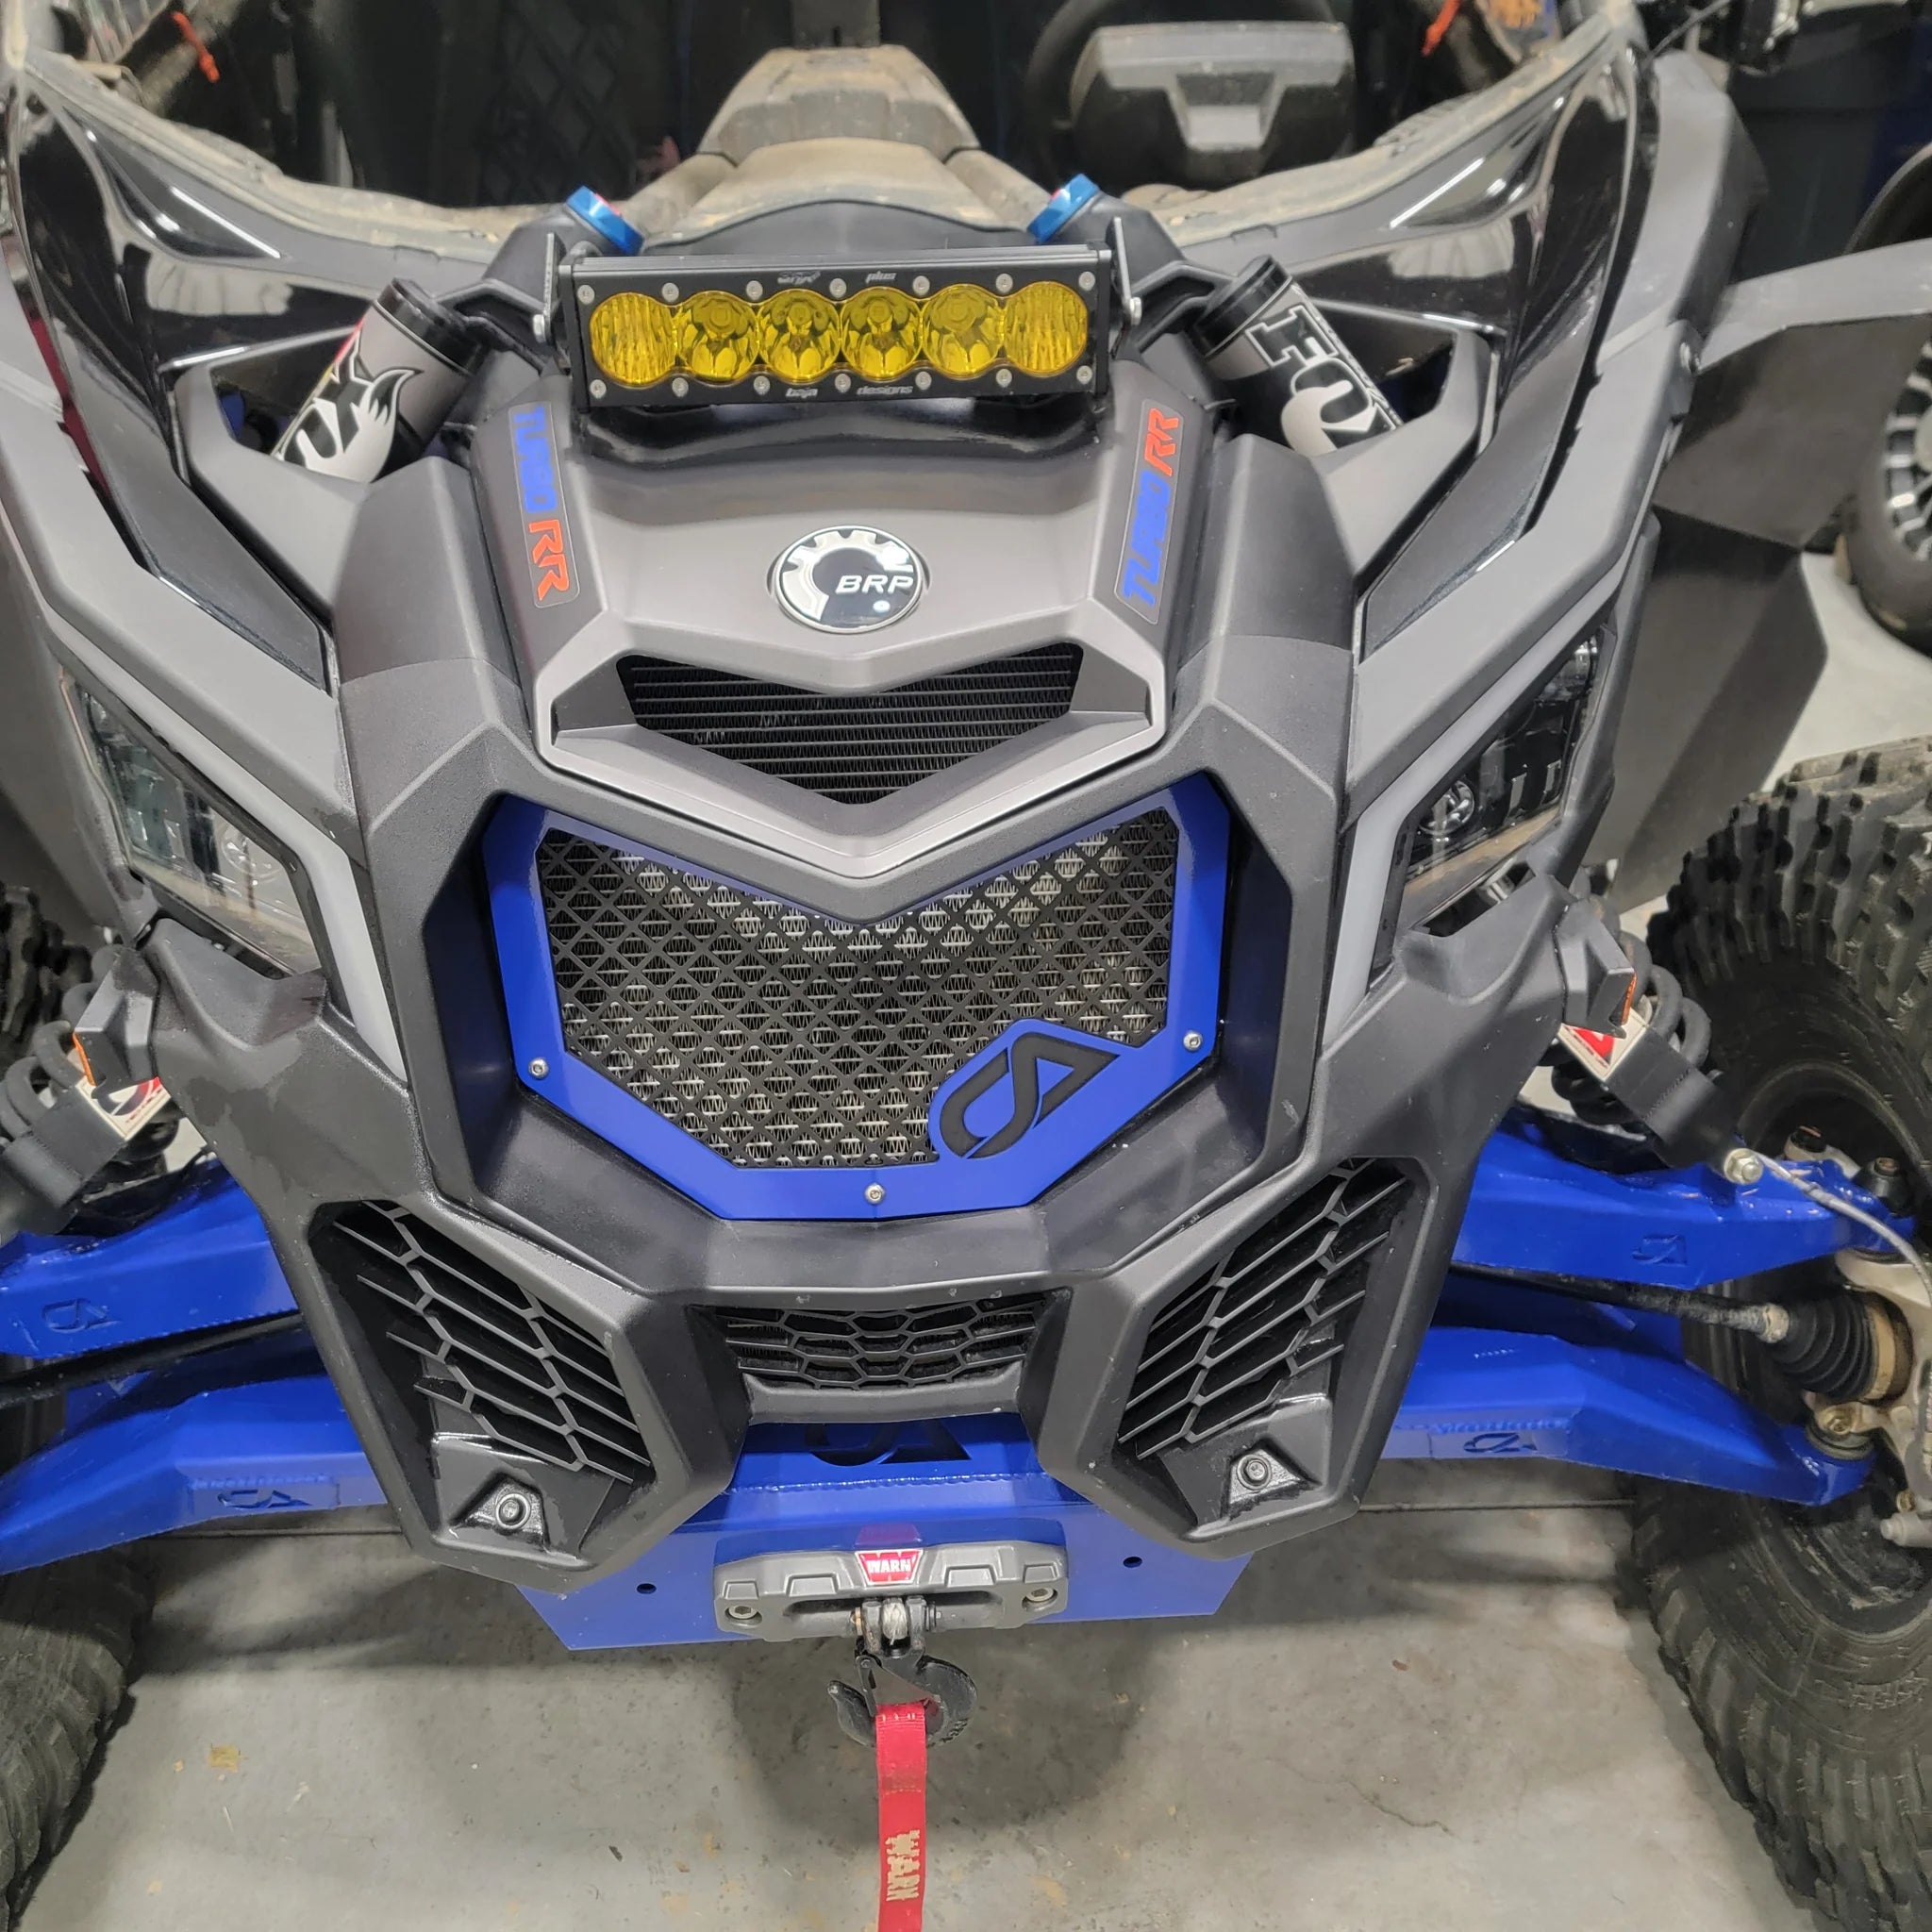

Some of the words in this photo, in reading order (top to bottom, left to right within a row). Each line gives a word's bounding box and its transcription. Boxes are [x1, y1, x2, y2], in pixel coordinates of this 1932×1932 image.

[856, 385, 914, 396] designs
[514, 405, 558, 513] TURBO
[1144, 408, 1180, 476] RR
[528, 519, 570, 602] RR
[1122, 469, 1172, 607] TURBO
[835, 575, 914, 594] BRP
[866, 1558, 911, 1574] WARN
[885, 1828, 921, 1902] WARN
